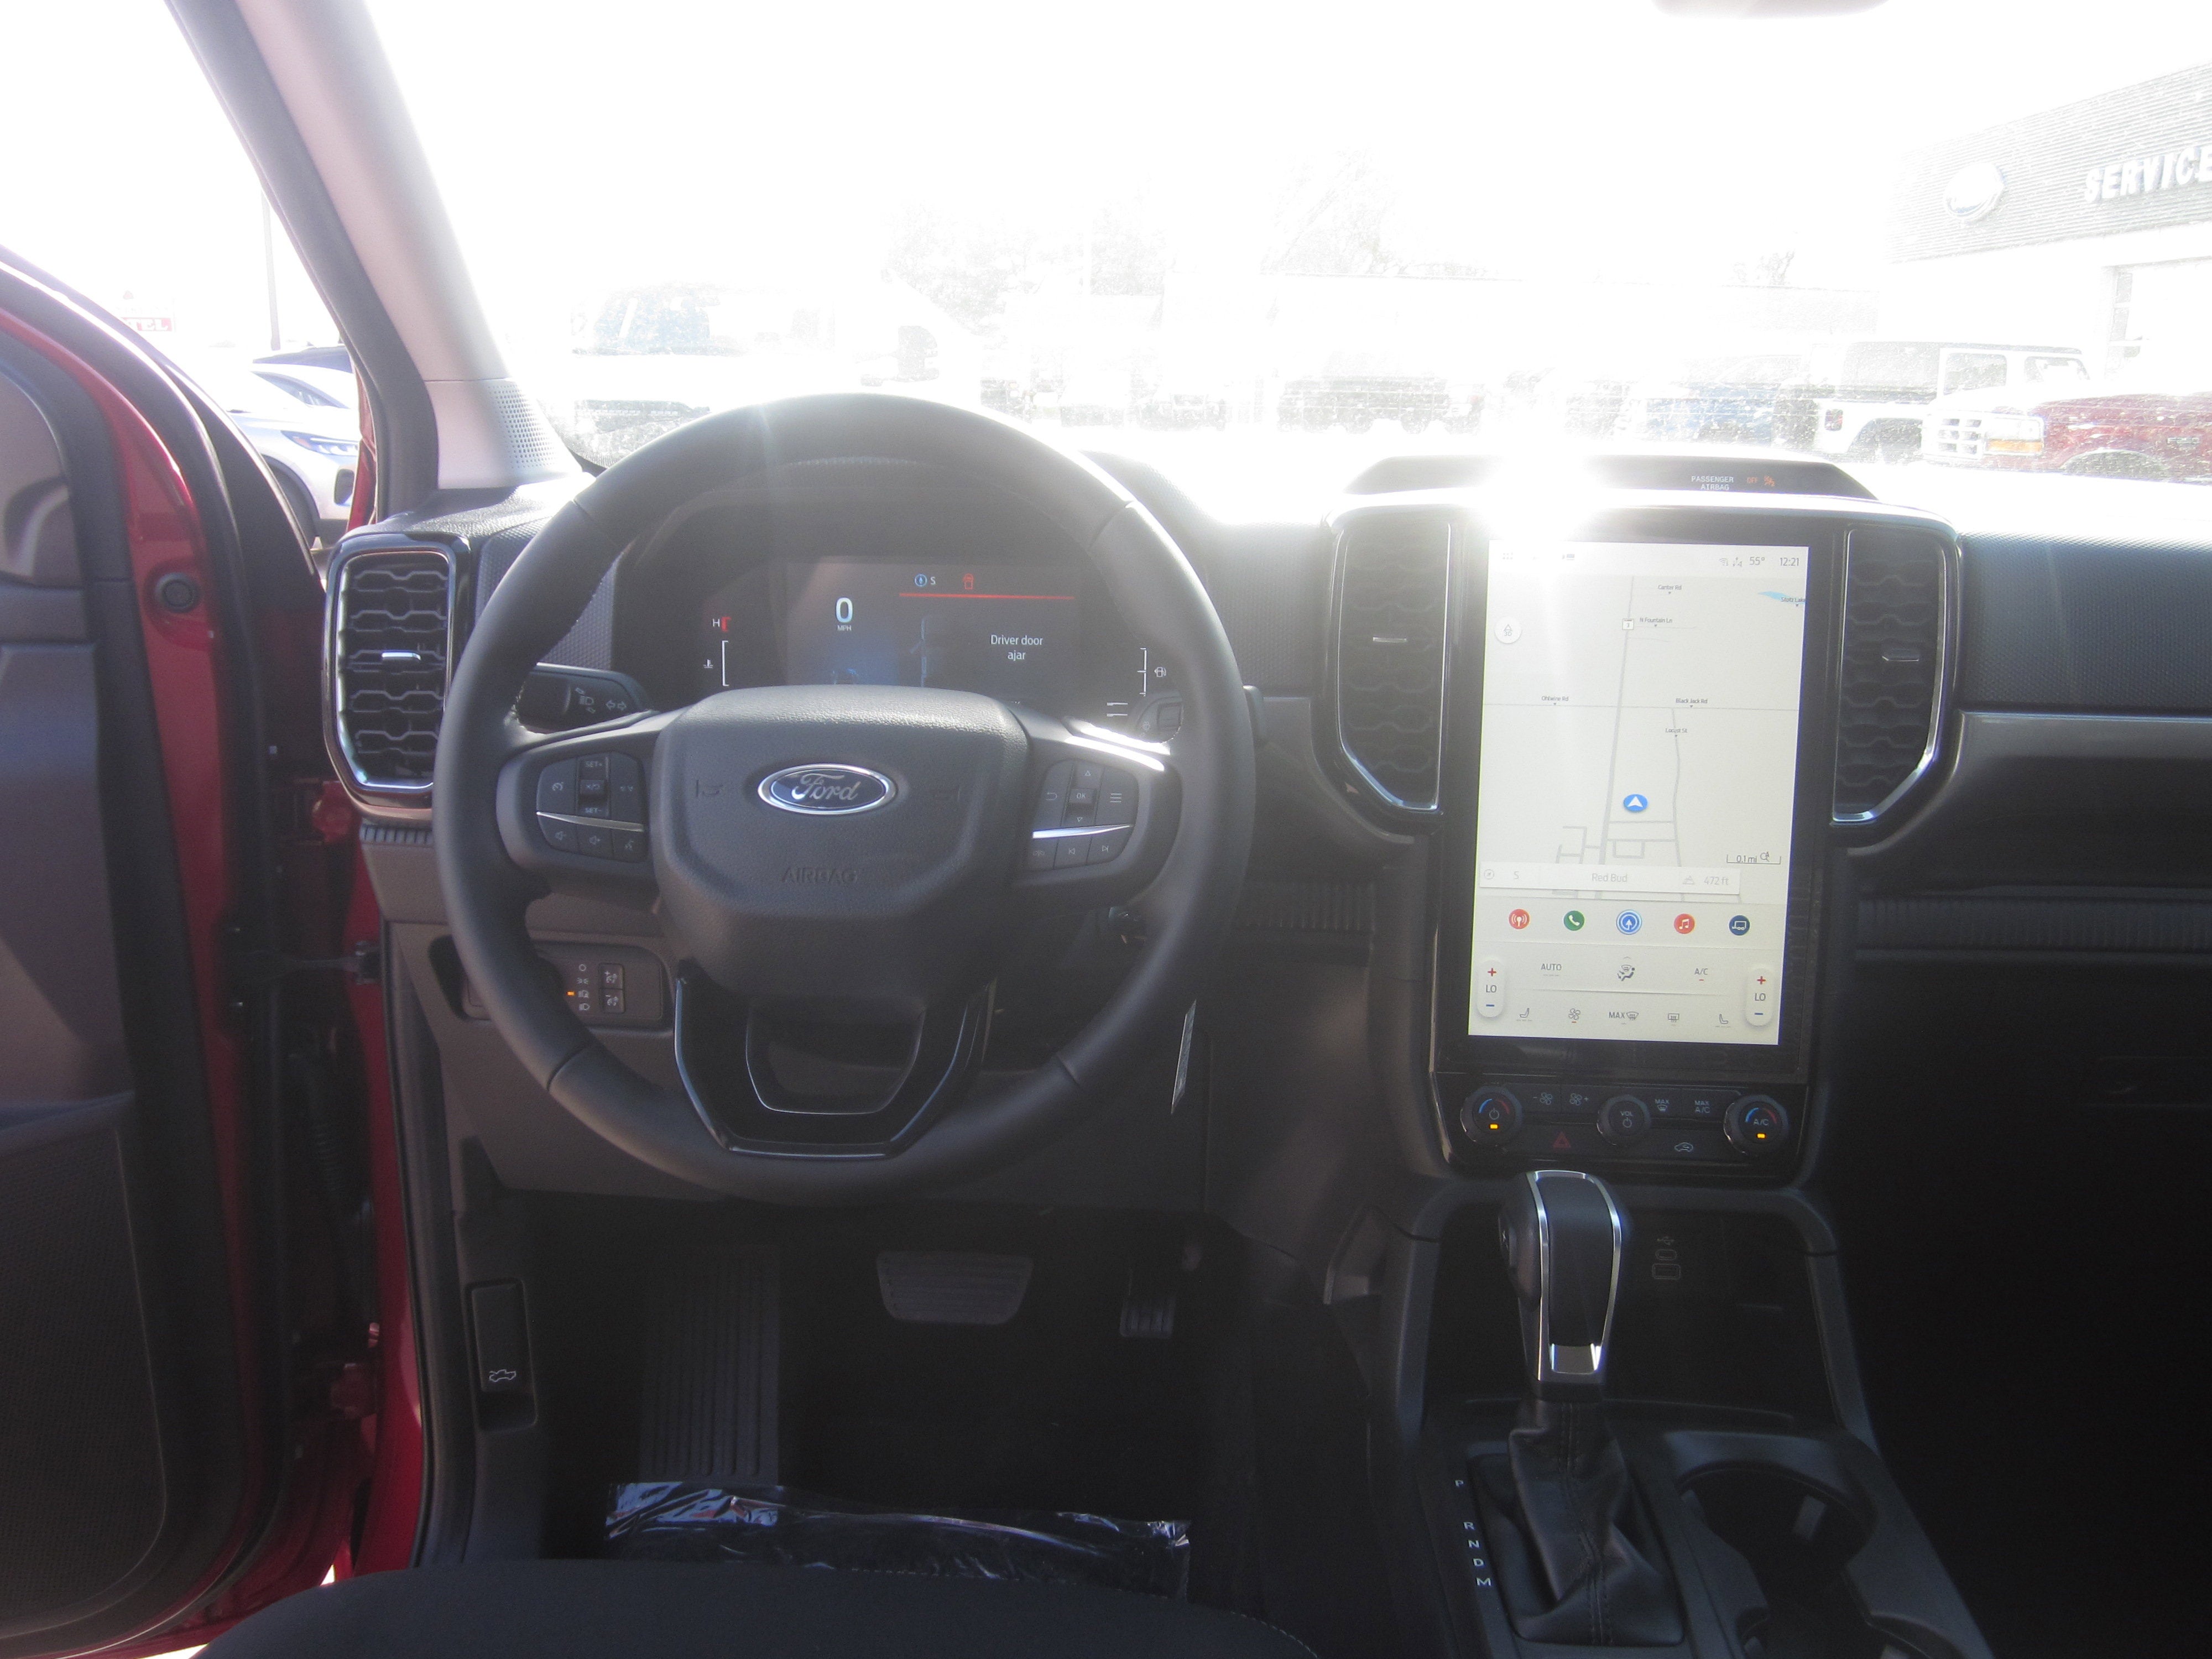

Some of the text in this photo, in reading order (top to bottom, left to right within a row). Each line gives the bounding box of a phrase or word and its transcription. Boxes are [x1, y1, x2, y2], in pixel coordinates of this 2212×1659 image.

[2084, 145, 2212, 202] SERVICE
[1779, 557, 1800, 566] 12:21
[930, 576, 936, 585] S
[836, 597, 853, 623] 0
[712, 618, 720, 627] H
[990, 634, 1043, 645] Driver door
[1008, 650, 1026, 661] ajar
[791, 773, 862, 800] Ford
[781, 866, 858, 885] AIRBAG
[1592, 873, 1609, 882] Red
[1610, 873, 1628, 883] Bud
[1704, 876, 1720, 885] 472
[1721, 877, 1729, 885] ft
[1541, 963, 1562, 972] AUTO
[1694, 968, 1708, 976] A/C
[1485, 984, 1497, 993] LO
[1754, 993, 1766, 1001] LO
[1609, 1011, 1625, 1020] MAX
[1468, 1540, 1480, 1548] N
[1476, 1578, 1491, 1586] M
